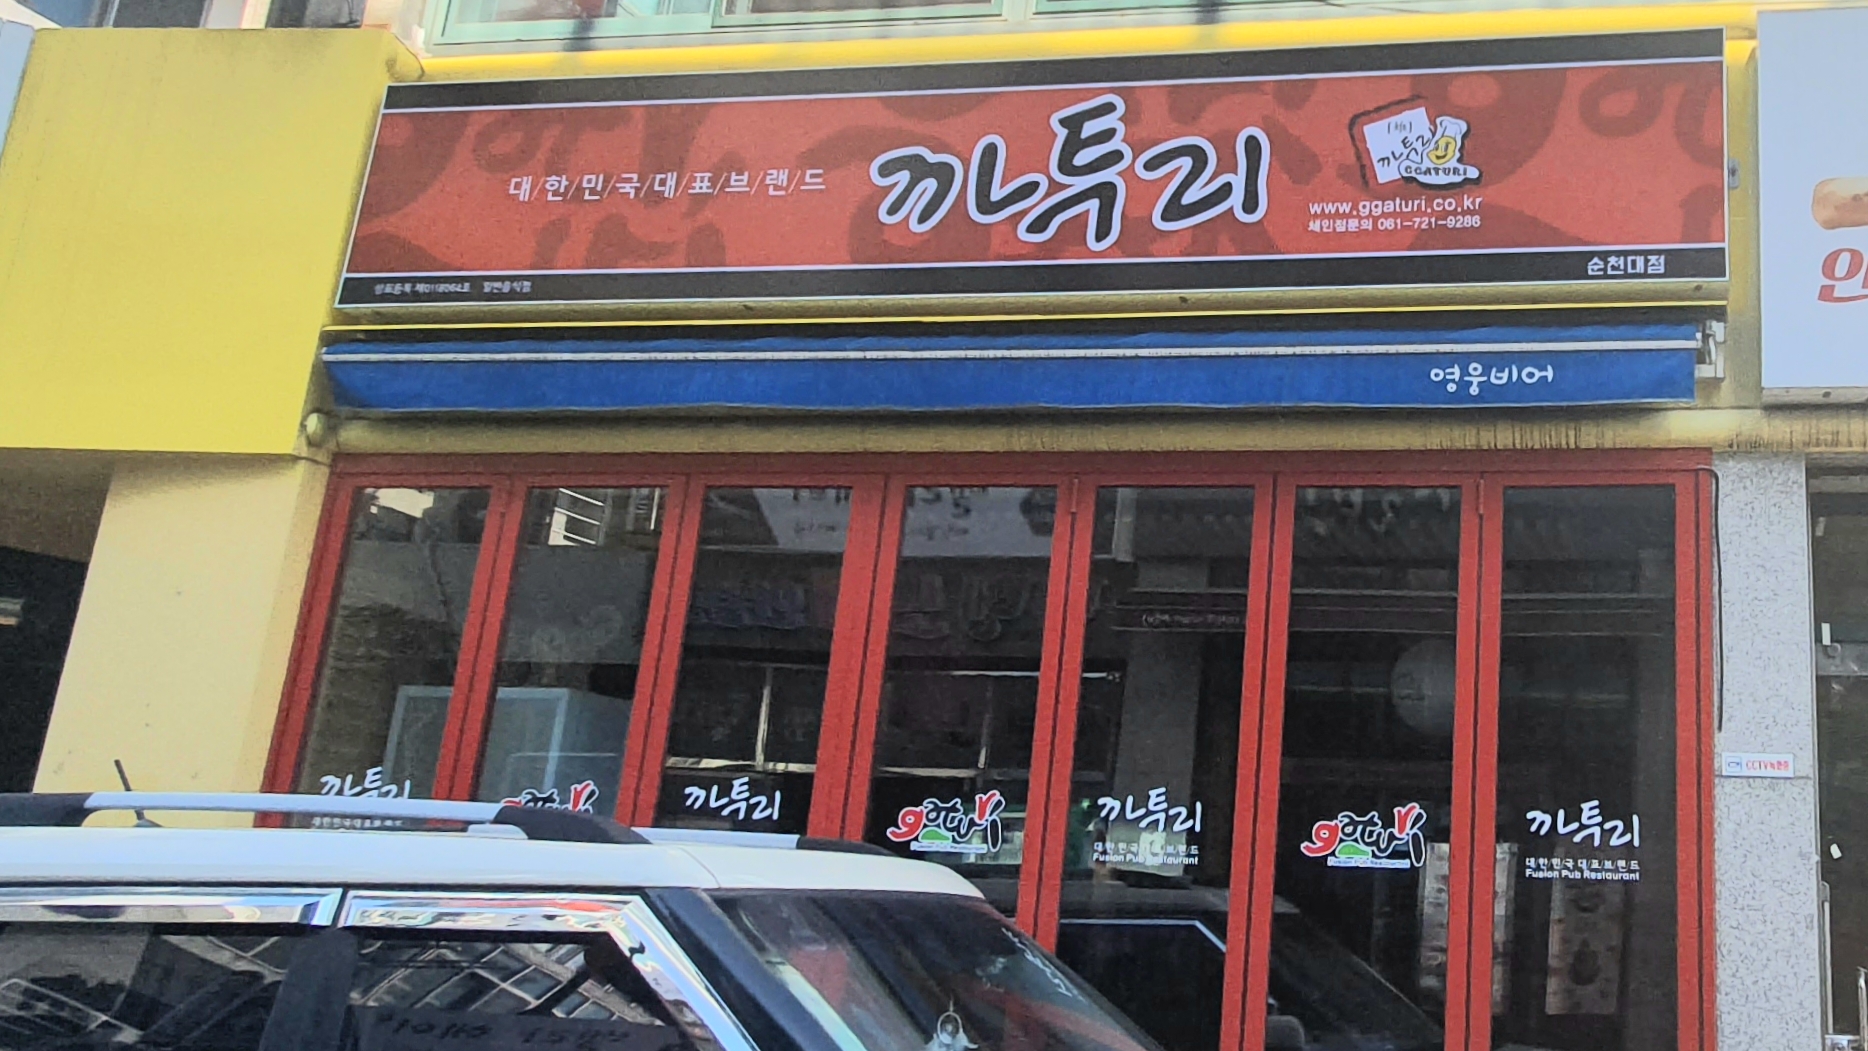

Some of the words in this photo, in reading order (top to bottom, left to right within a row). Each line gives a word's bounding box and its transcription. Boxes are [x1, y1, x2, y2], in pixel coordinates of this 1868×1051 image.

[1308, 194, 1483, 217] www.ggaturi.co.kr
[1377, 215, 1481, 230] 061-721-9286
[1587, 254, 1666, 276] 순천대점
[1430, 362, 1554, 396] 영웅비어
[1526, 869, 1559, 879] Fusion
[1562, 870, 1581, 880] Pub
[1583, 870, 1640, 881] Restaurant
